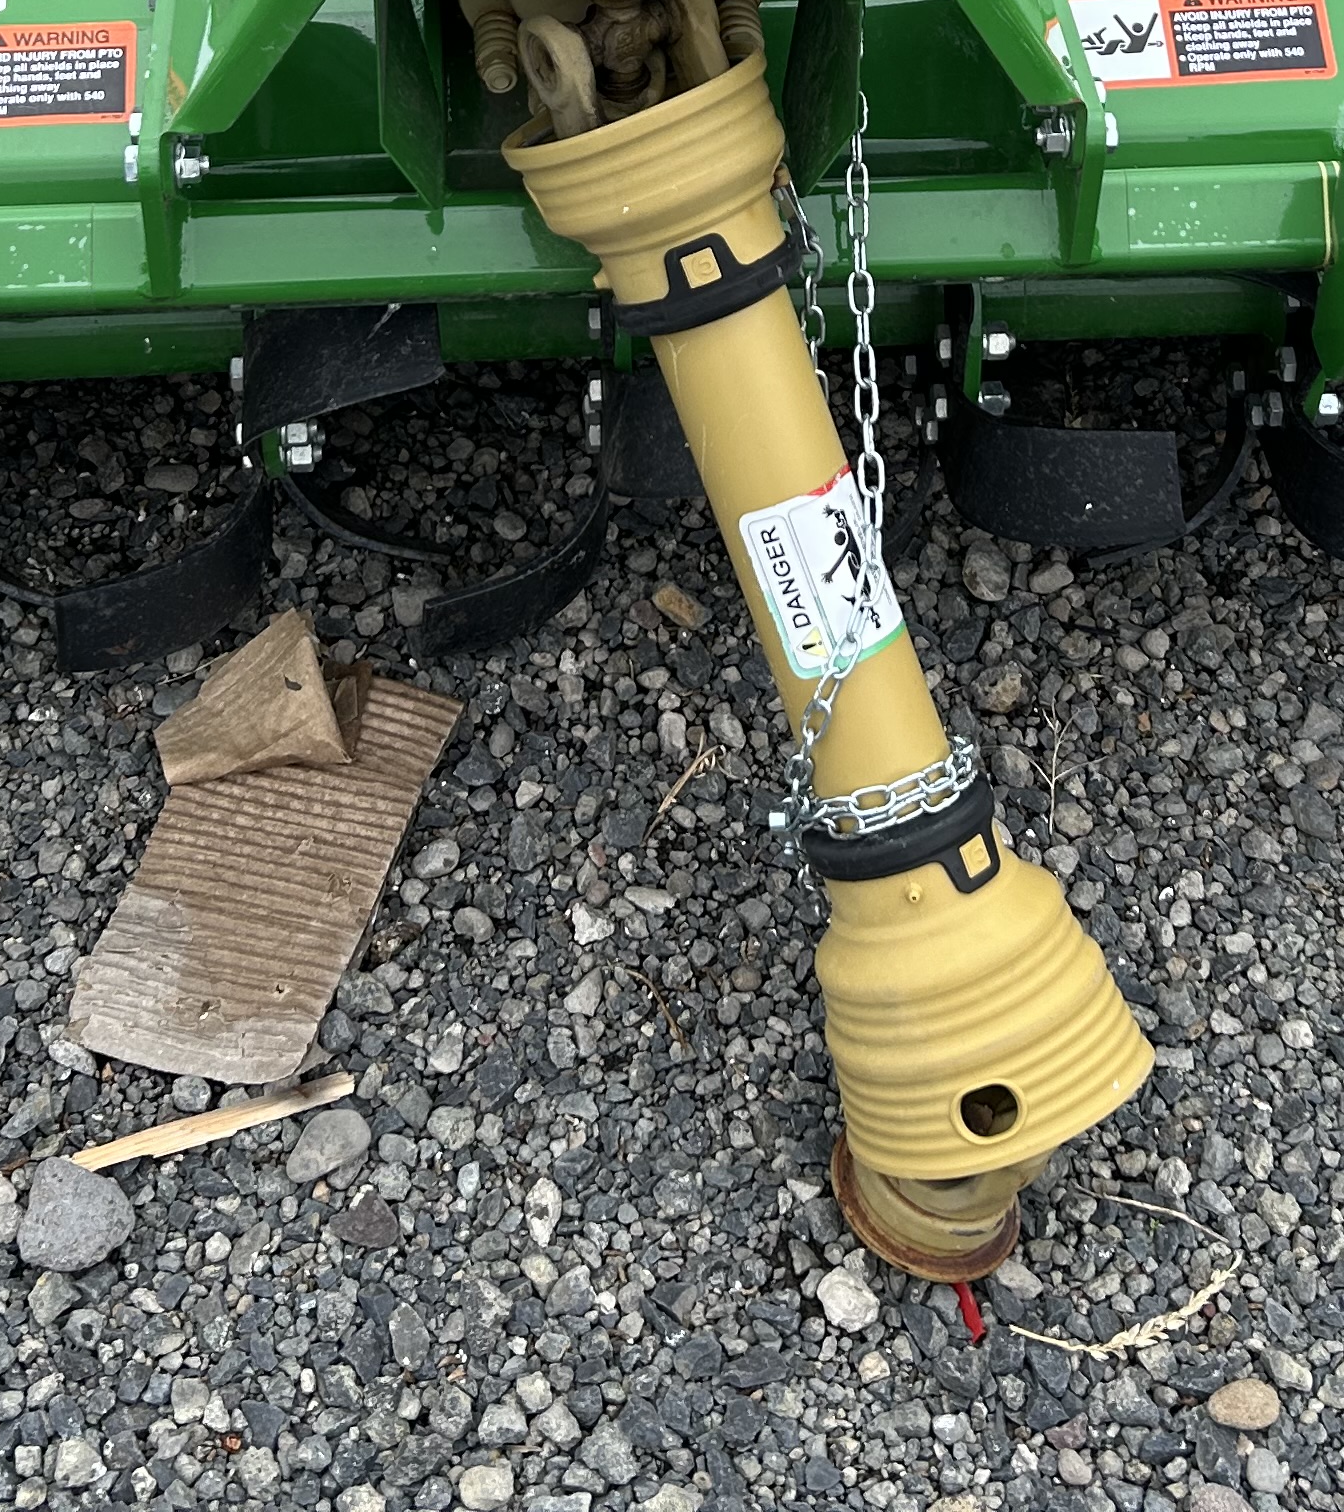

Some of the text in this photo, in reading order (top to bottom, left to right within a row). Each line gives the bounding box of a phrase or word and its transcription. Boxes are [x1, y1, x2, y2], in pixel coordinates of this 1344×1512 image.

[1173, 6, 1313, 21] AVOID INJURY FROM PTO
[1182, 16, 1312, 32] Keep all shields in place
[14, 30, 110, 46] WARNING
[1183, 31, 1213, 42] Keep
[1252, 27, 1274, 37] feet
[1275, 26, 1297, 36] and
[1185, 40, 1261, 52] clothing away
[13, 51, 57, 61] INJURY
[60, 49, 96, 60] FROM
[98, 48, 123, 58] PTO
[1187, 46, 1305, 62] Operate only with 540
[13, 63, 27, 72] all
[30, 61, 72, 71] shields
[75, 60, 86, 69] in
[88, 59, 119, 70] place
[1189, 62, 1216, 72] RPM
[55, 70, 77, 80] feet
[78, 70, 101, 79] and
[30, 83, 60, 93] away
[28, 92, 54, 104] only
[56, 91, 81, 101] with
[84, 90, 105, 100] 540
[761, 524, 812, 629] DANGER
